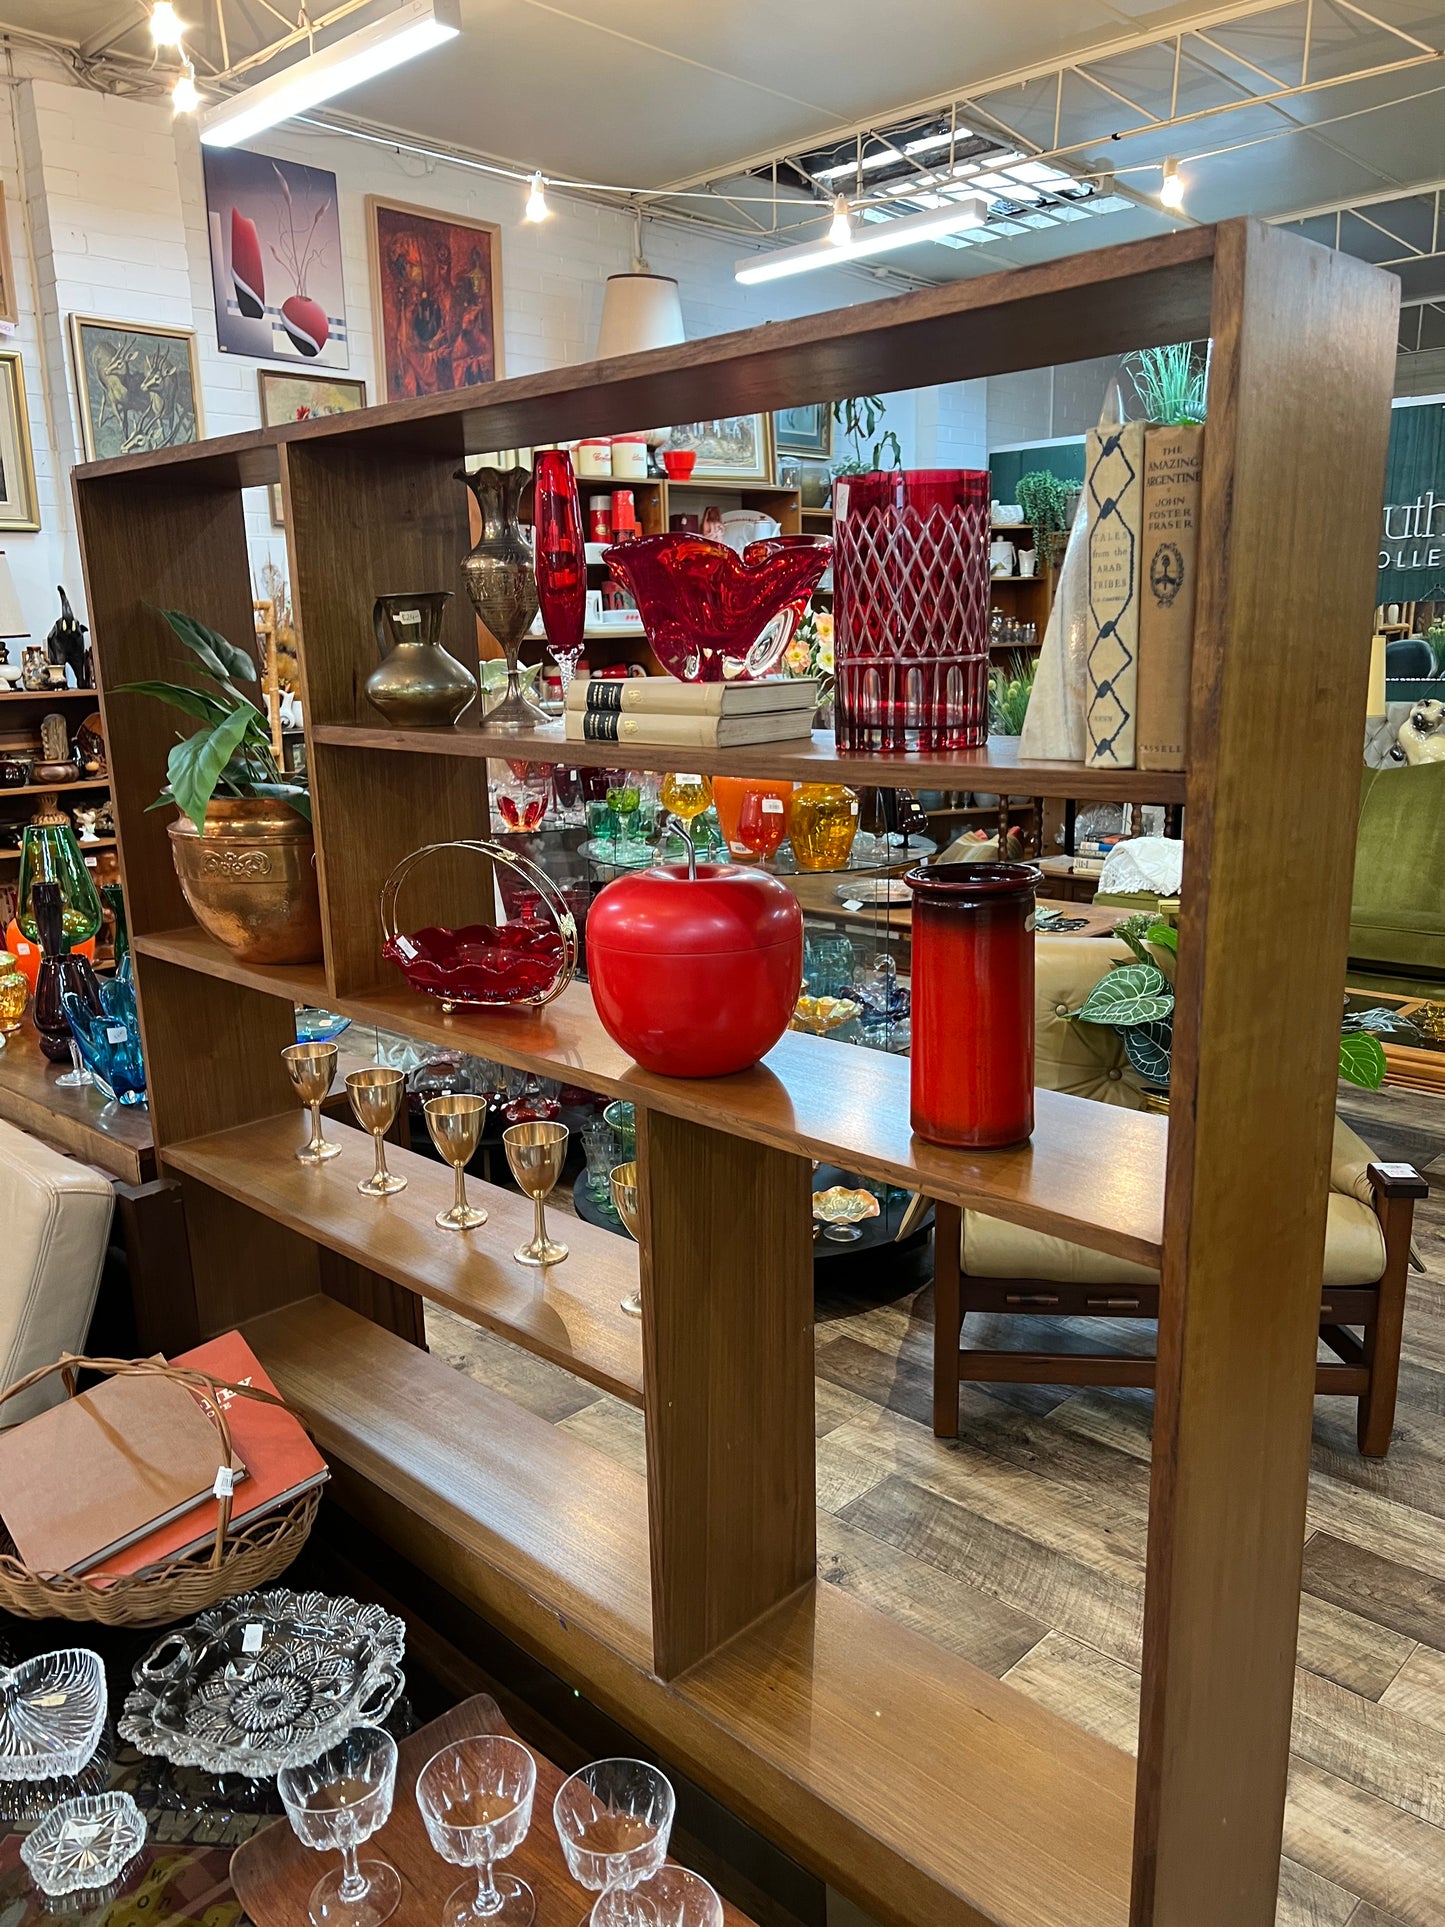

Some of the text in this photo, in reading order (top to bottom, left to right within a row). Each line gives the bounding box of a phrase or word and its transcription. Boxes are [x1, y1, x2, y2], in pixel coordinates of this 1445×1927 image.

[1163, 445, 1183, 456] THE
[1148, 457, 1200, 472] AMAZING
[1147, 471, 1201, 488] ARGENTINE
[1155, 496, 1186, 508] JOHN
[1148, 508, 1192, 520] FOSTER
[1148, 519, 1194, 532] FRASER
[1093, 531, 1128, 543] TALES
[1092, 546, 1128, 559] from the
[1096, 562, 1122, 574] ARAB
[1093, 578, 1127, 590] TRIBES
